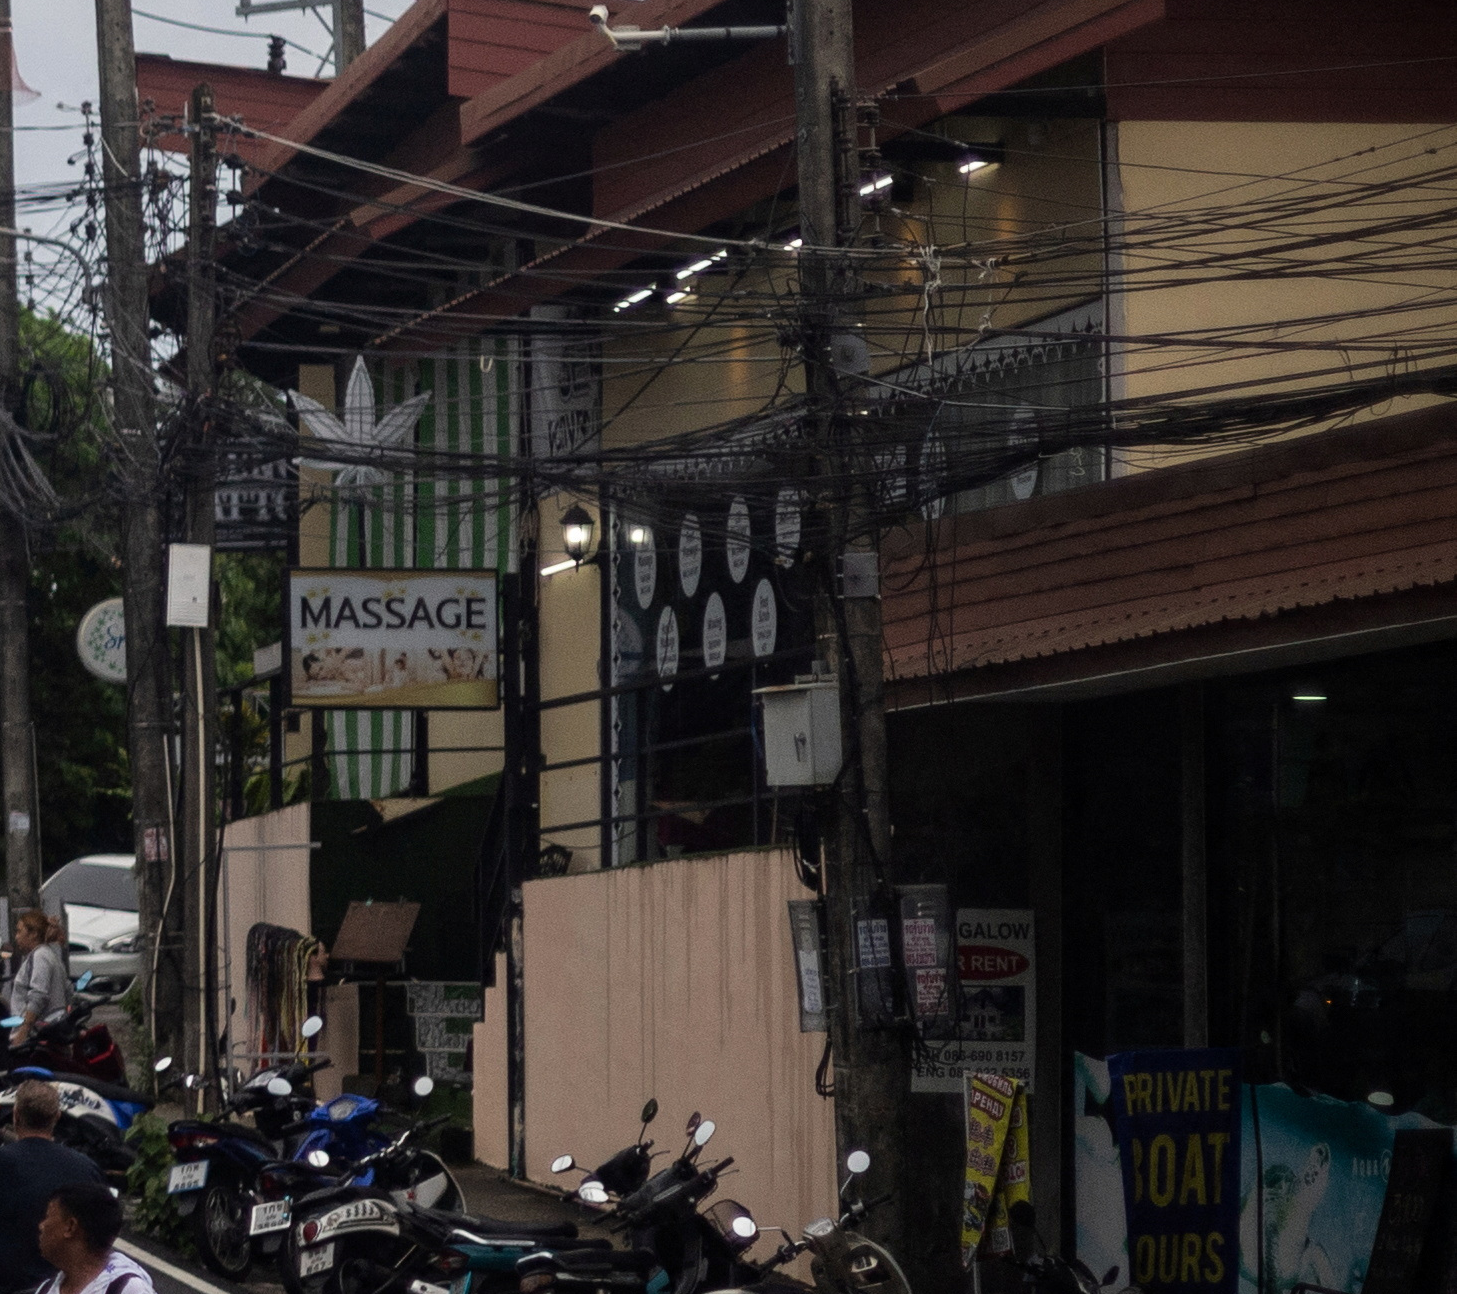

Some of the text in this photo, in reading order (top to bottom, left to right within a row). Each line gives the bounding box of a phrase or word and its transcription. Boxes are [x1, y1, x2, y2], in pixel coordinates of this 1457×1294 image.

[300, 595, 487, 630] MASSAGE
[971, 954, 1021, 972] RENT
[1123, 1069, 1232, 1116] PRIVATE
